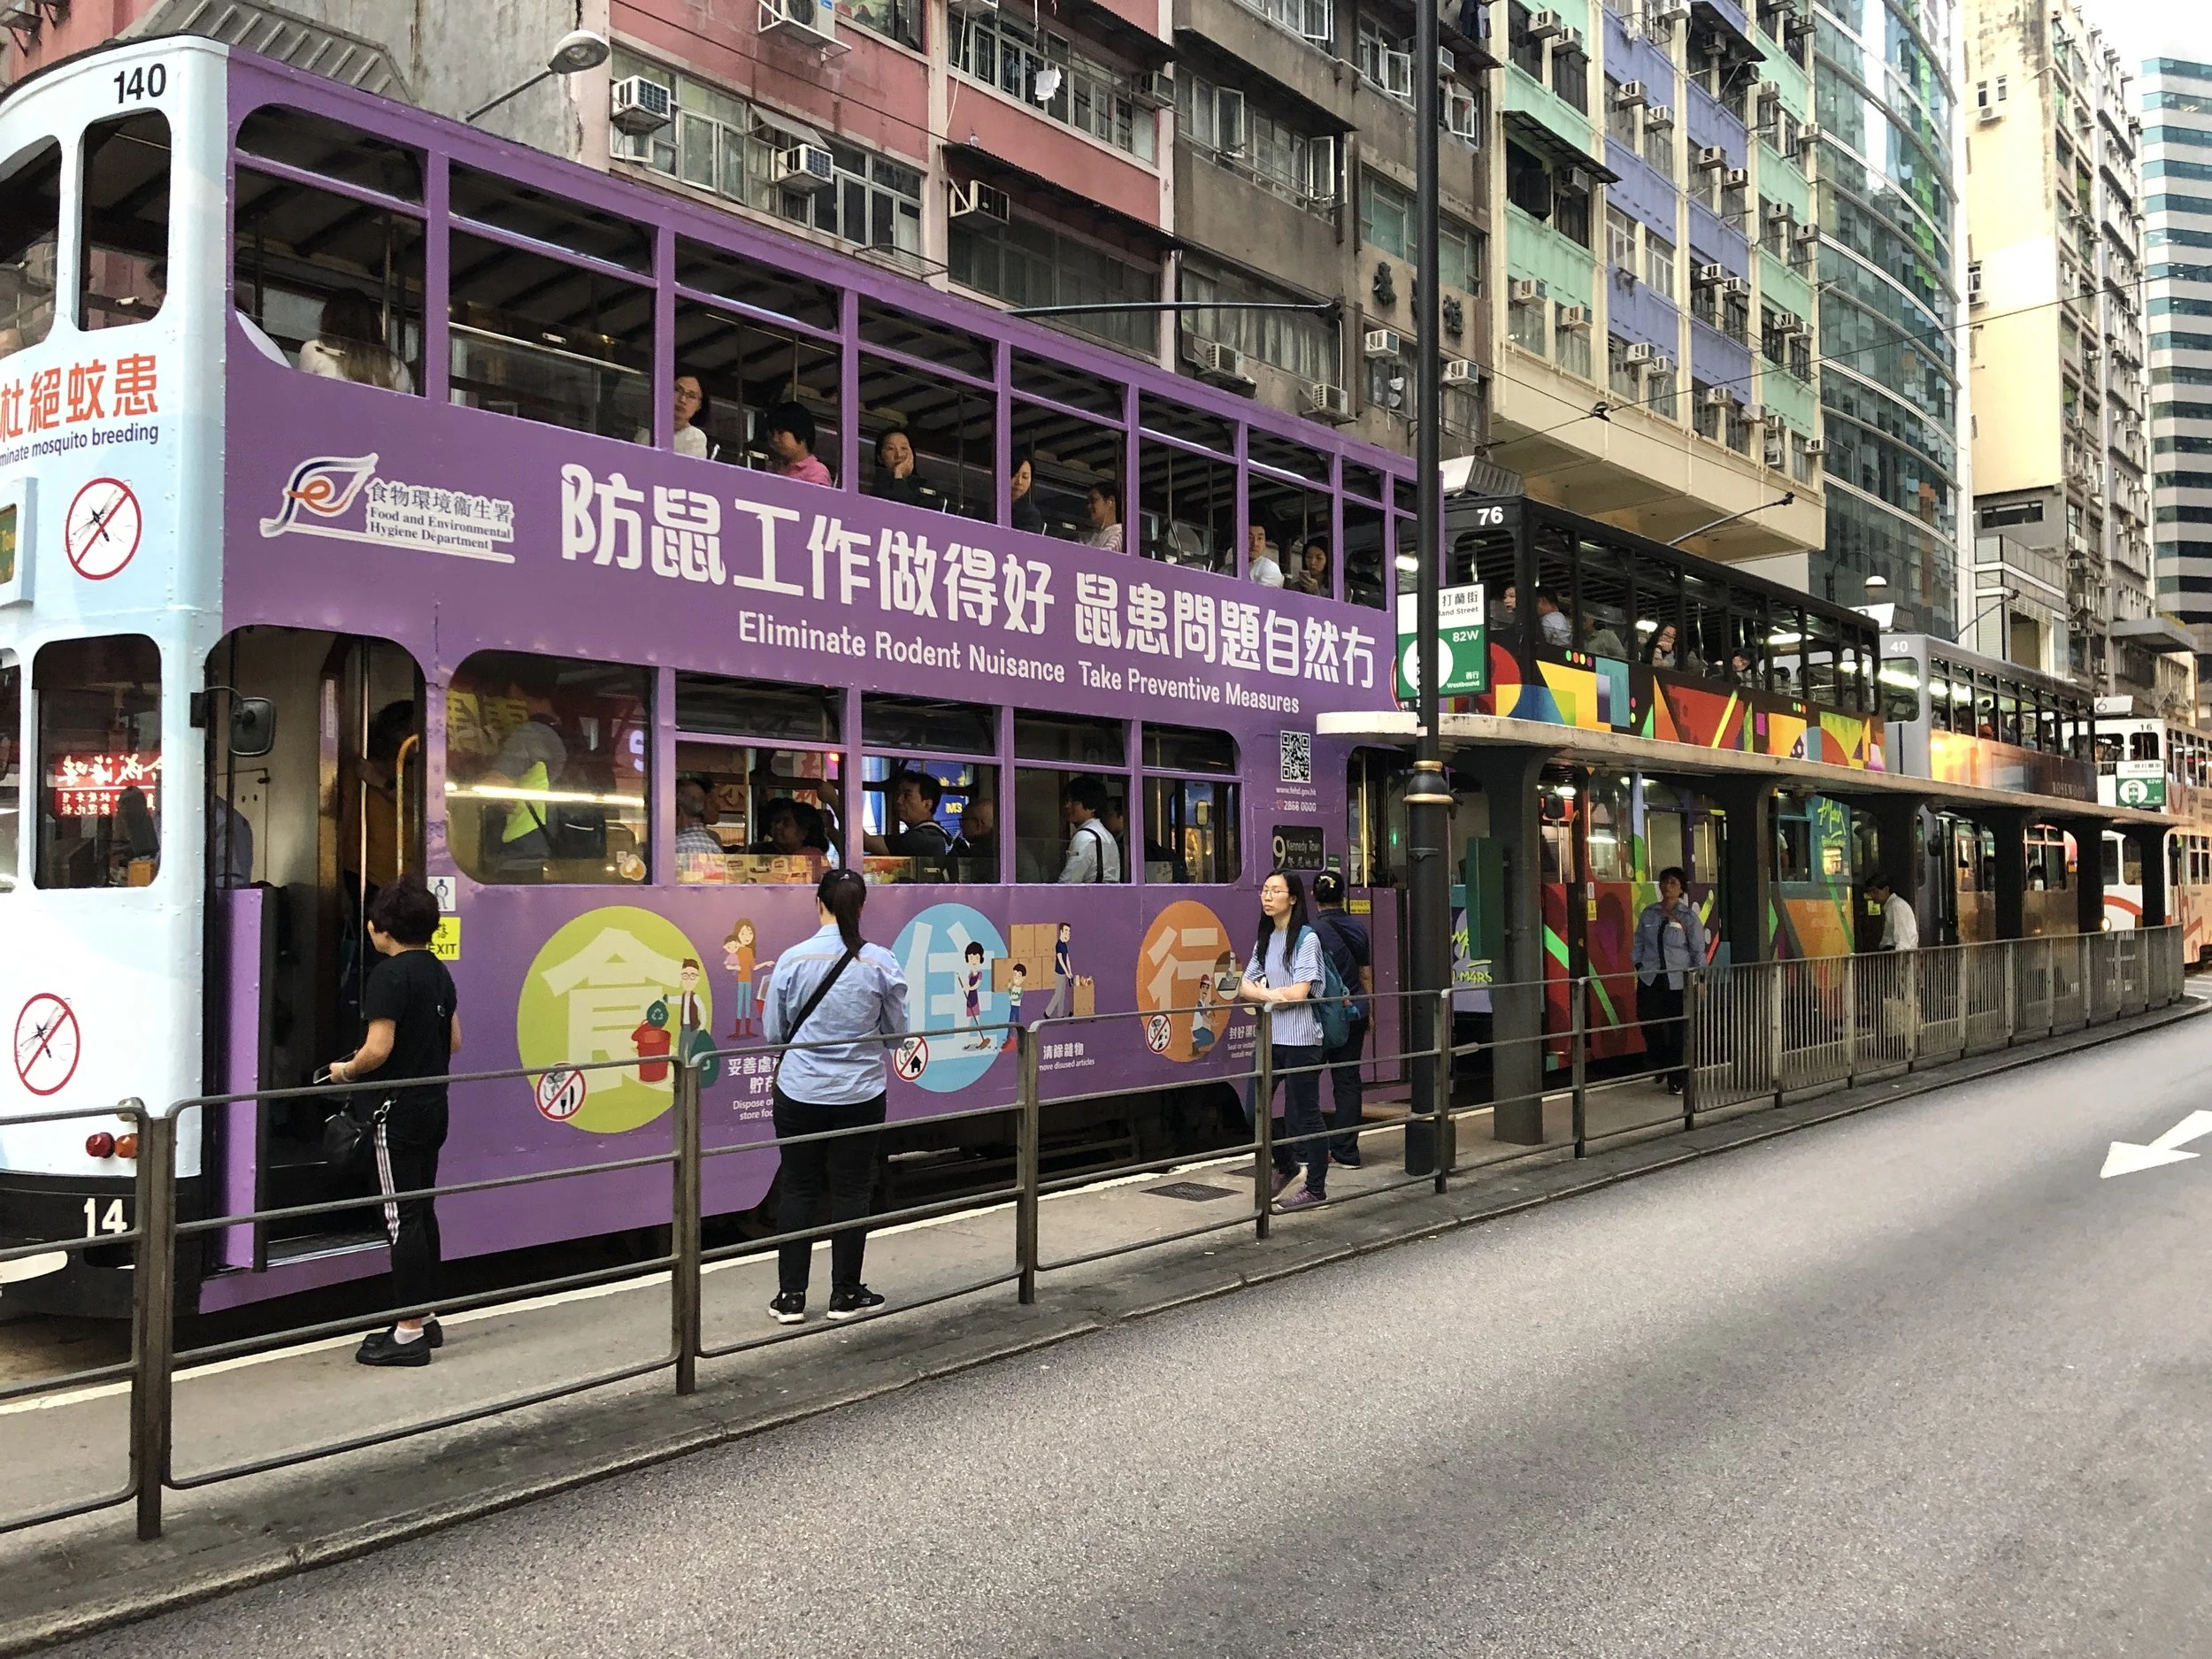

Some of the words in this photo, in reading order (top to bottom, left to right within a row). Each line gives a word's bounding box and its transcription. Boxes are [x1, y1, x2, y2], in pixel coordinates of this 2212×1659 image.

[112, 63, 167, 104] 140
[0, 353, 158, 442] 杜絕蚊患
[32, 432, 88, 456] mosquito
[92, 423, 159, 445] breeding
[371, 507, 400, 521] Food
[403, 513, 425, 526] and
[428, 517, 511, 540] Environmental
[1477, 506, 1504, 526] 76
[371, 521, 419, 539] Hygiene
[422, 529, 489, 549] Department
[561, 463, 1056, 635] 防鼠工作做得好
[1075, 572, 1376, 689] 鼠患問題自然冇
[1456, 606, 1479, 615] Street
[1452, 630, 1479, 642] 82W
[1890, 641, 1909, 653] 40
[740, 611, 866, 657] Eliminate
[875, 631, 962, 671] Rodent
[969, 645, 1065, 684] Nuisance
[1079, 660, 1122, 691] Take
[1127, 667, 1220, 704] Preventive
[1225, 681, 1300, 714] Measures
[1447, 680, 1480, 688] Westbound
[1272, 835, 1286, 870] 9
[907, 921, 997, 1062] 住
[1147, 926, 1218, 1051] 行
[1054, 1060, 1075, 1069] disused
[1076, 1058, 1095, 1067] articles
[733, 1099, 764, 1110] Dispose
[740, 1110, 760, 1121] store
[84, 1197, 127, 1239] 14
